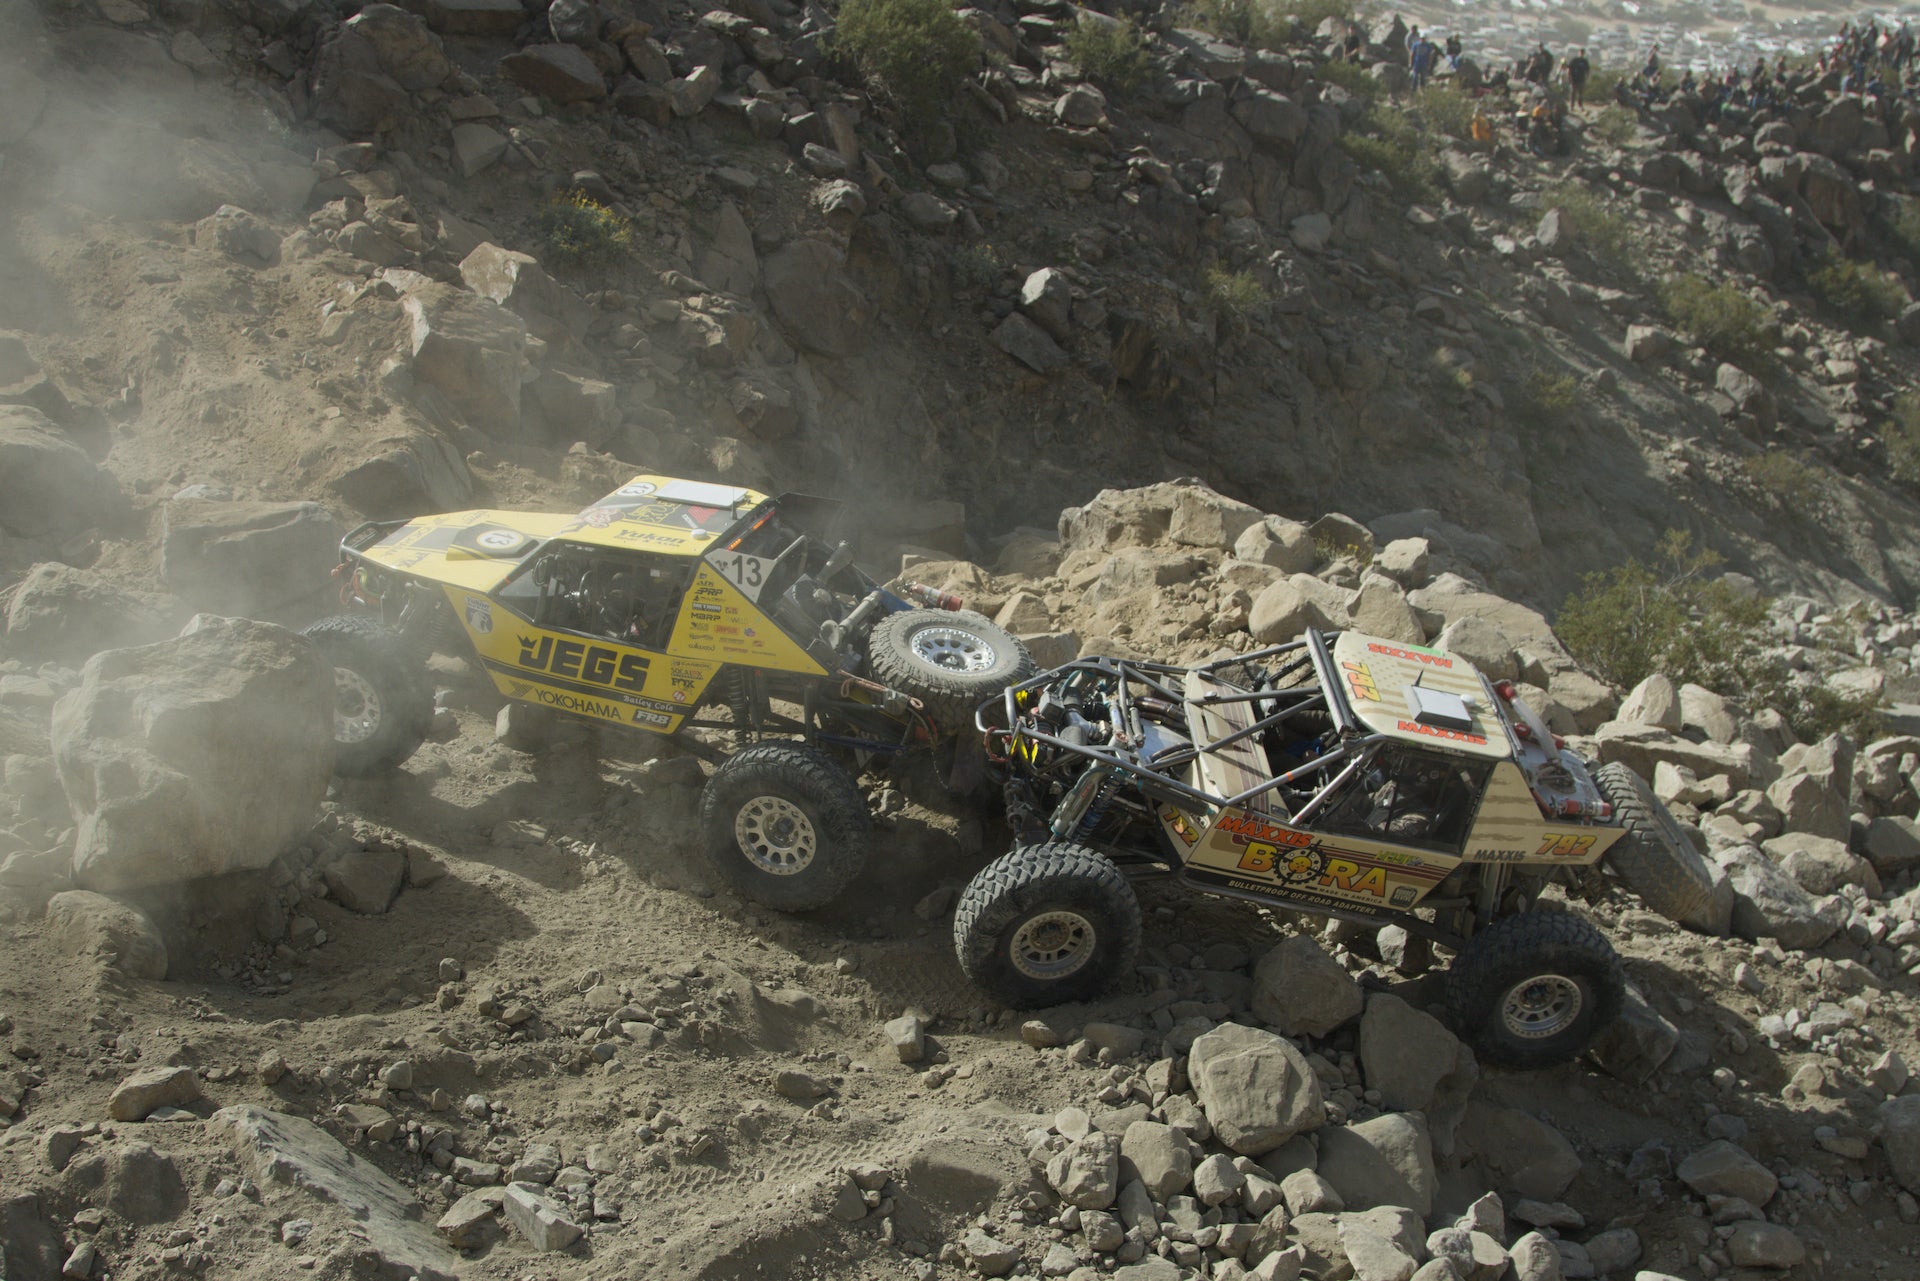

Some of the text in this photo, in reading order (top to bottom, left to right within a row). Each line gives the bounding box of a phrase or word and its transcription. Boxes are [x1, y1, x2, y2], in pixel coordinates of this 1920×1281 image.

[484, 533, 515, 547] 13
[619, 529, 686, 545] Yukon
[732, 555, 762, 587] 13
[519, 636, 651, 692] JEGS
[1367, 643, 1452, 668] MAXXIS
[1342, 661, 1381, 702] 792
[534, 688, 622, 720] YOKOHAMA
[1398, 720, 1487, 745] MAXXIS
[1215, 815, 1314, 848] MAXXIS
[1474, 849, 1527, 862] MAXXIS
[1536, 833, 1598, 856] 792
[1228, 880, 1377, 915] BULLETPROOF OFF ROAD ADAPTERS
[1319, 887, 1338, 896] MADE
[1351, 894, 1383, 904] AMERICA
